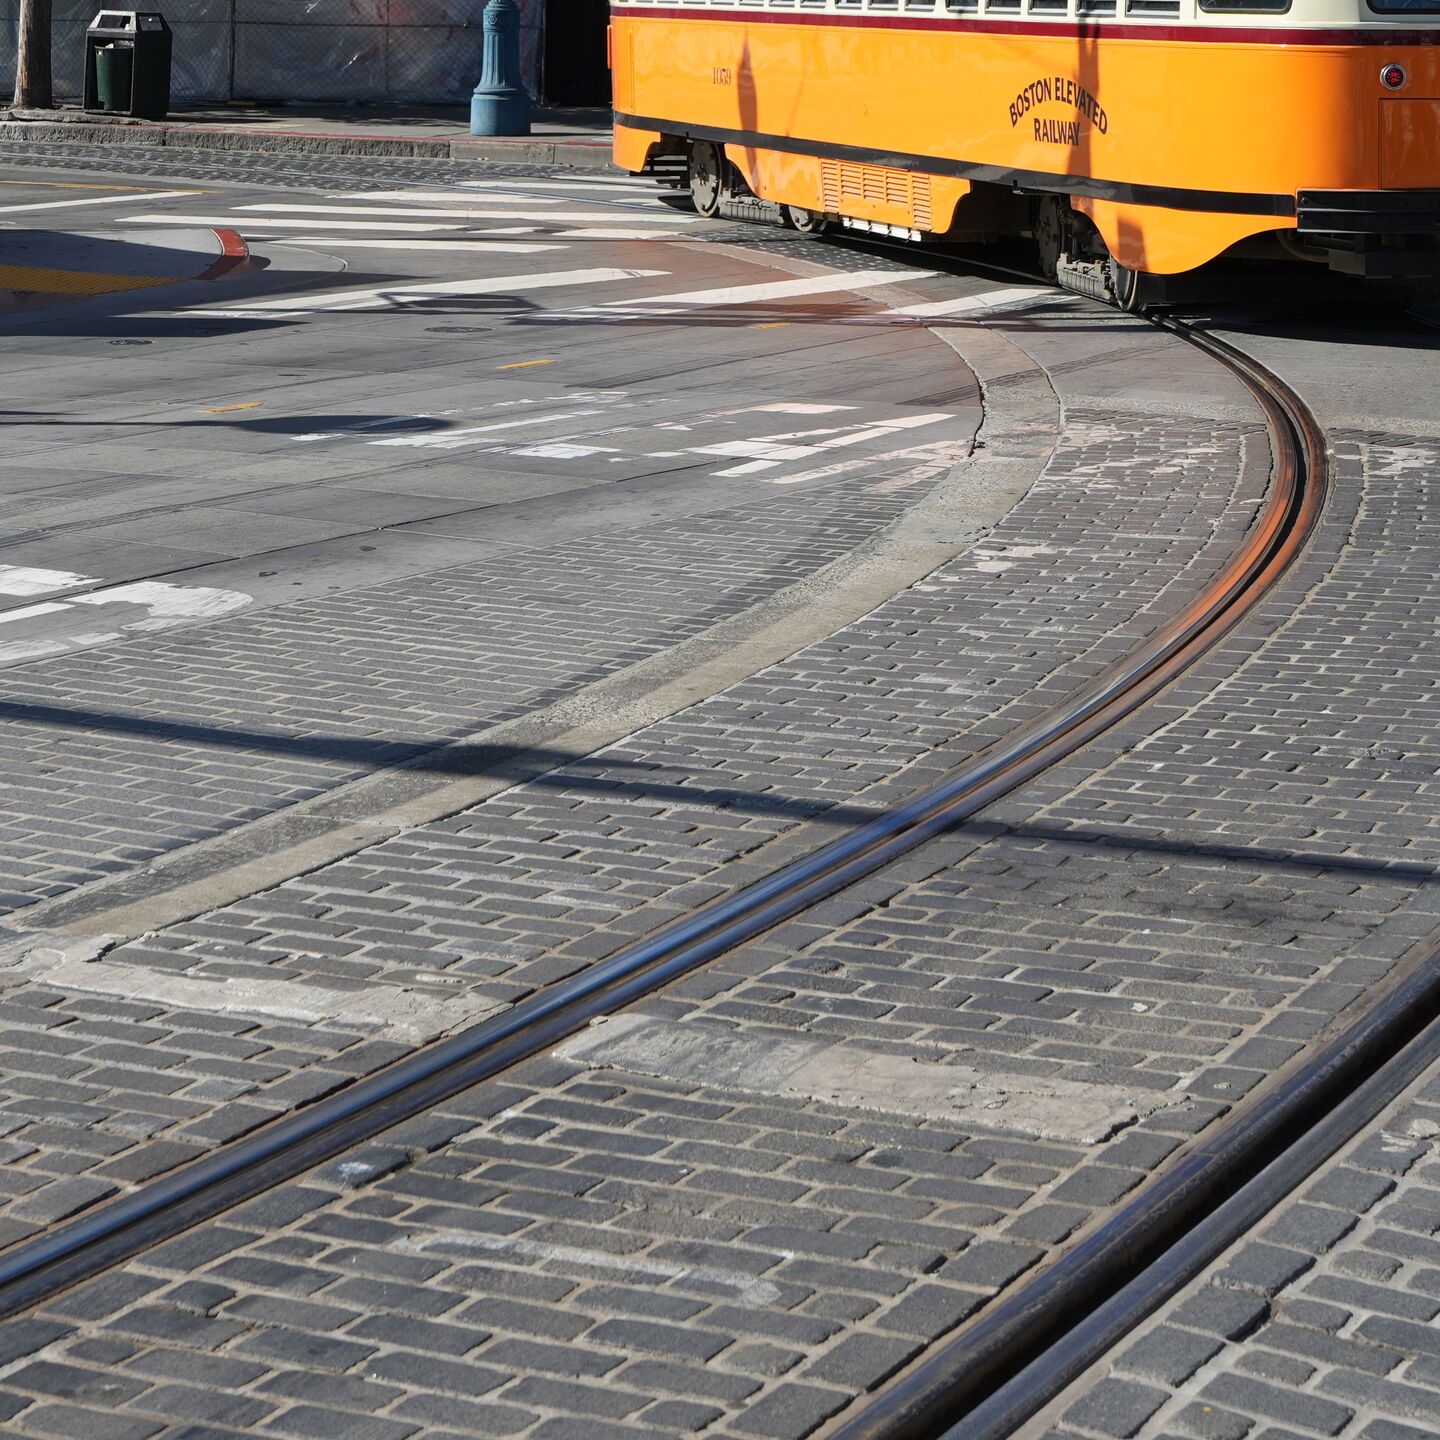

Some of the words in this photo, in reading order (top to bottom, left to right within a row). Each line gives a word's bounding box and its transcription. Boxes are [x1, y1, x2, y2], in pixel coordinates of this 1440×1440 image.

[1009, 77, 1051, 127] BOSTON
[1055, 77, 1107, 134] ELEVATED
[1034, 118, 1080, 146] RAILWAY
